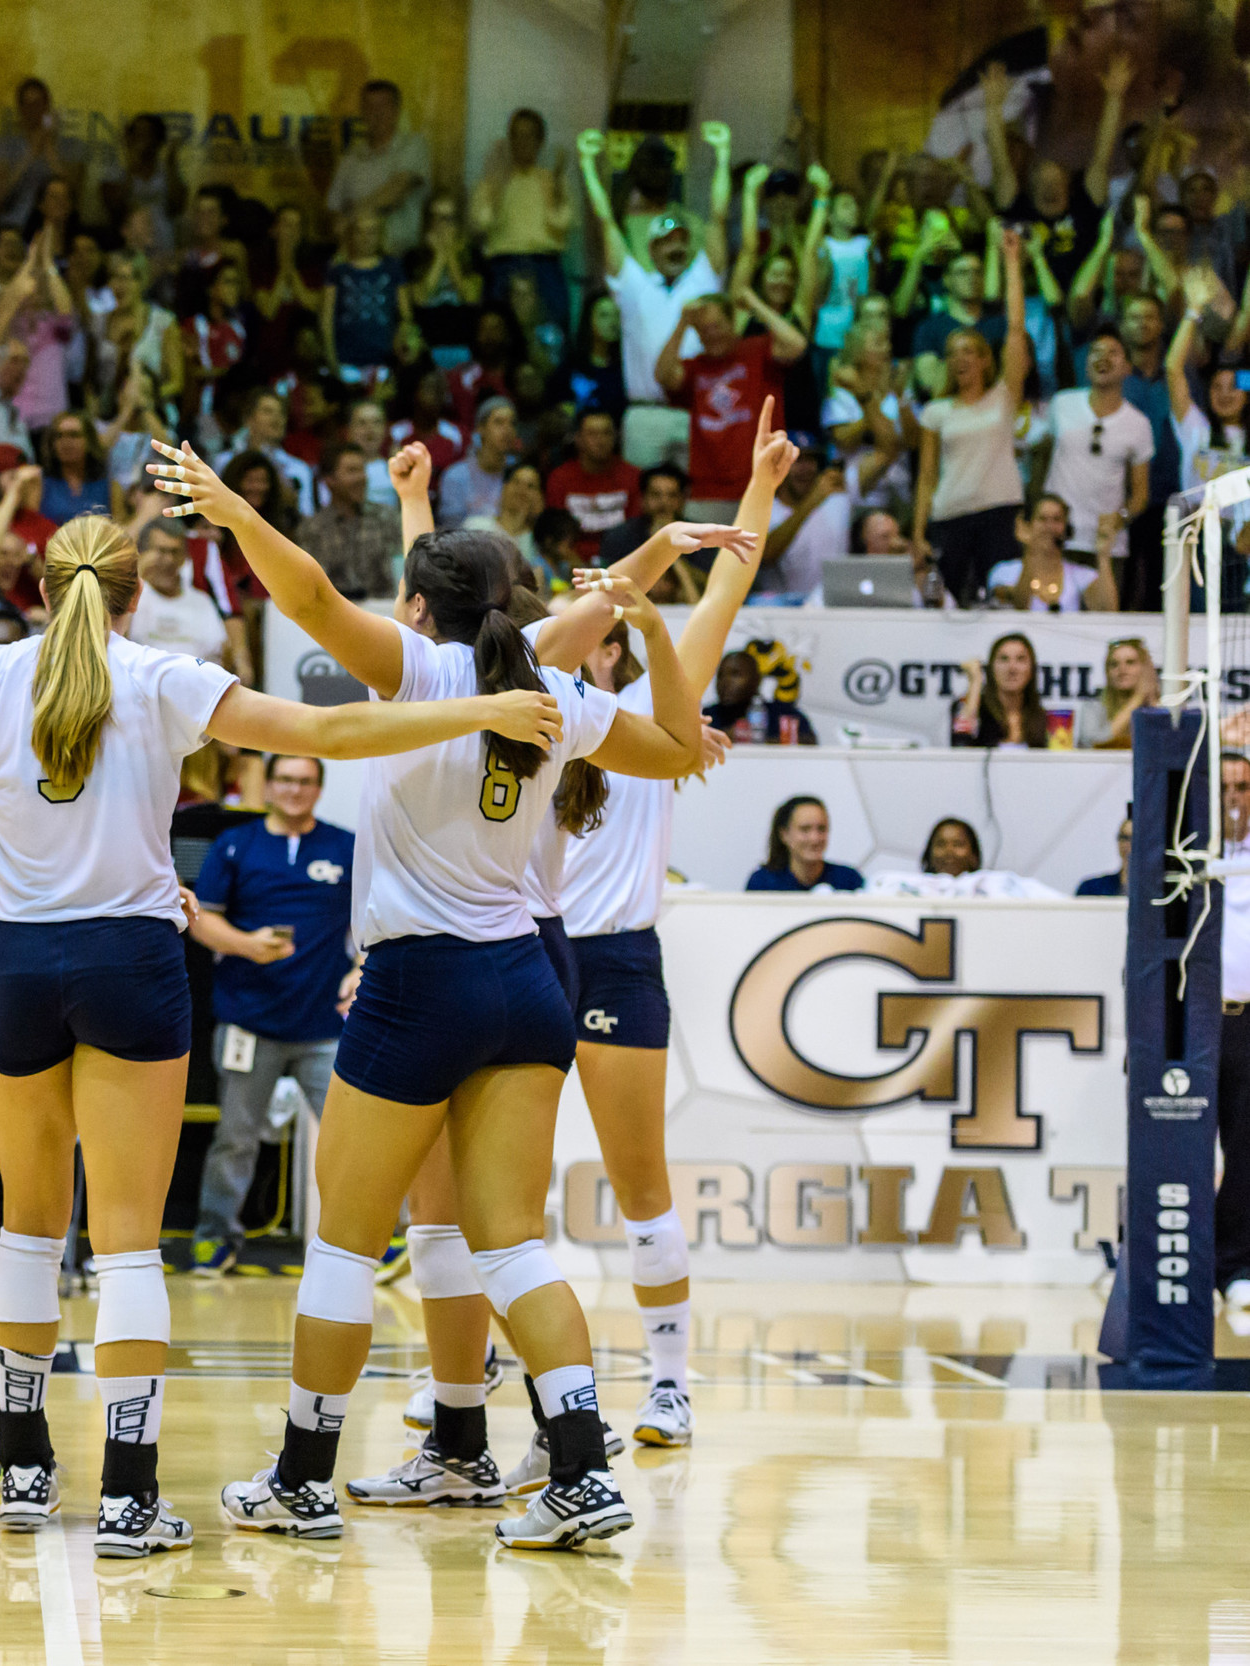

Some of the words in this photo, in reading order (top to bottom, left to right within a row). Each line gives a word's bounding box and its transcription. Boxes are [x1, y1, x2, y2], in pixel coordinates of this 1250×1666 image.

[584, 1009, 619, 1034] GT
[729, 916, 1104, 1150] GT
[543, 1159, 1029, 1250] ORGIA
